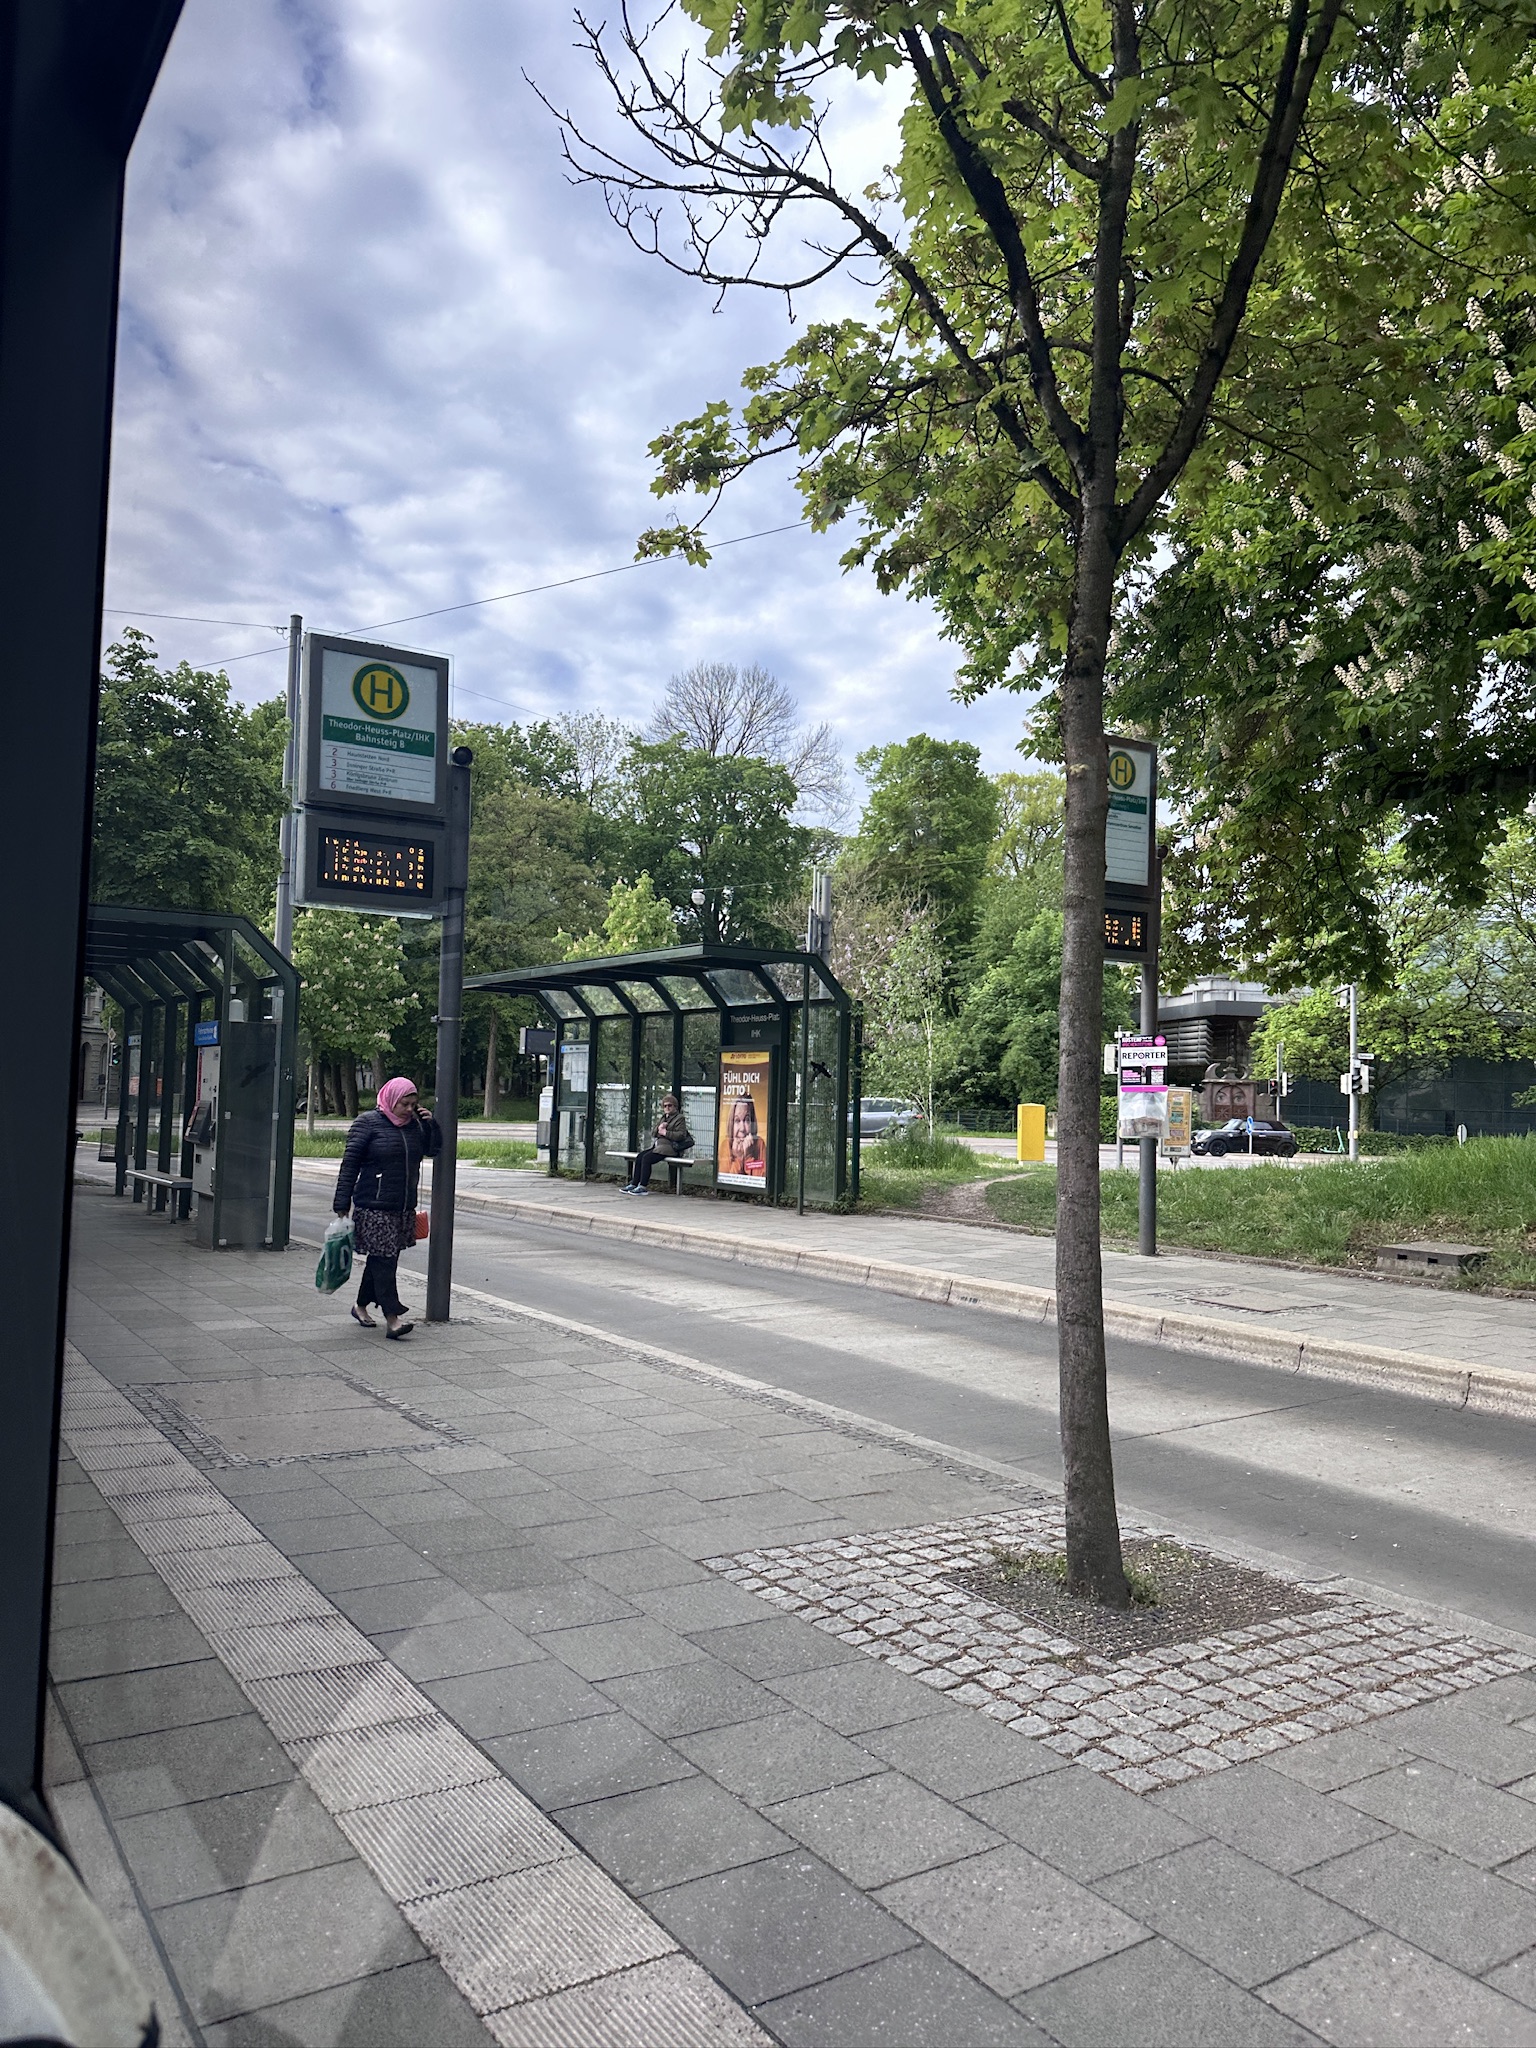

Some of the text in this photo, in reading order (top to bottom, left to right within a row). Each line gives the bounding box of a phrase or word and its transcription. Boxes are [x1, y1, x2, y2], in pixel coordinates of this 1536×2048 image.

[370, 675, 393, 708] H
[329, 719, 431, 743] Theodor-Heuss-Platz/IHK
[355, 733, 405, 749] Bahnsteig B
[332, 748, 337, 756] 2
[332, 759, 337, 767] 3
[331, 770, 336, 778] 3
[1116, 759, 1127, 782] H
[331, 781, 336, 789] 6
[751, 1029, 761, 1037] IHK
[723, 1071, 760, 1083] FÜHL DICH
